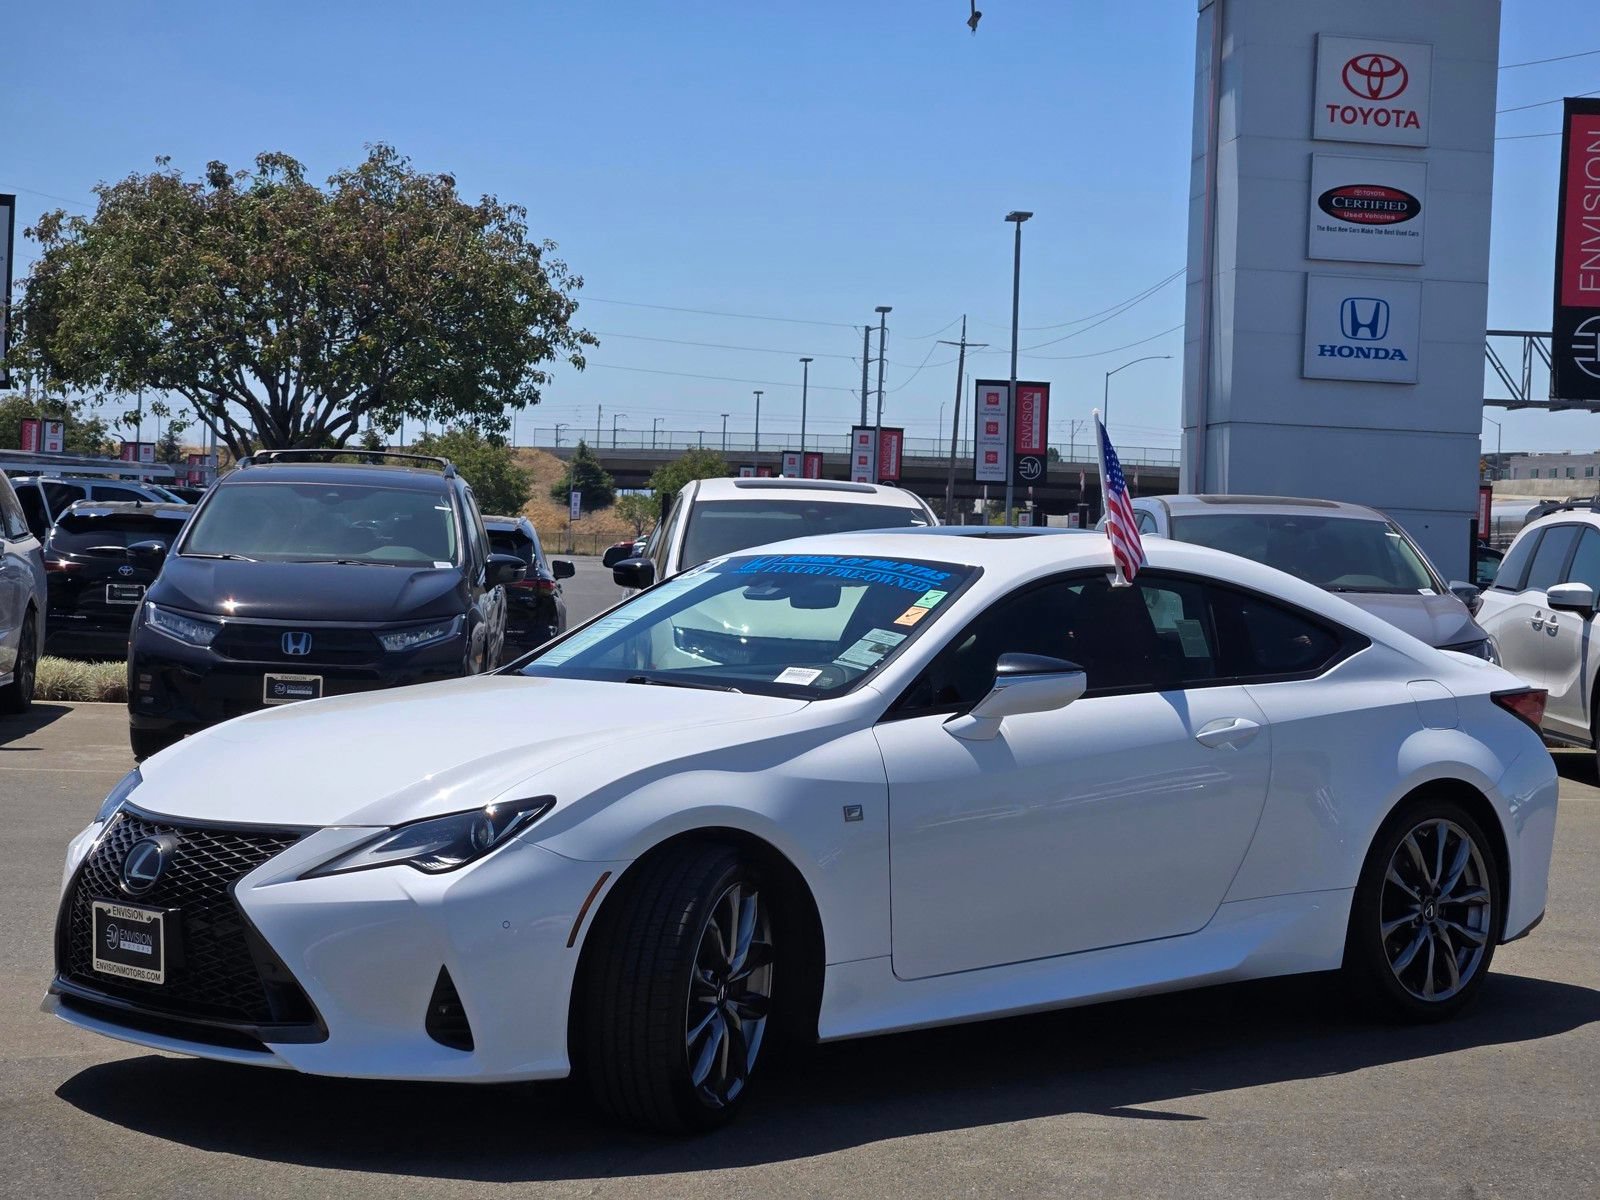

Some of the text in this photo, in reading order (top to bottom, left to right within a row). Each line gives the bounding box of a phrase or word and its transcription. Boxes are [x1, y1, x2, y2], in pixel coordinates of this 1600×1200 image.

[1326, 104, 1420, 129] TOYOTA
[1344, 211, 1396, 220] Used Vehicles
[1579, 130, 1600, 291] ENVISION
[1318, 345, 1408, 361] HONDA
[1021, 391, 1033, 449] ENVISION
[762, 565, 932, 592] LUXURY PRE-OWNED
[112, 906, 144, 920] ENVISION
[120, 928, 153, 946] ENVISION
[96, 960, 161, 982] ENVISIONMOTORS.COM
